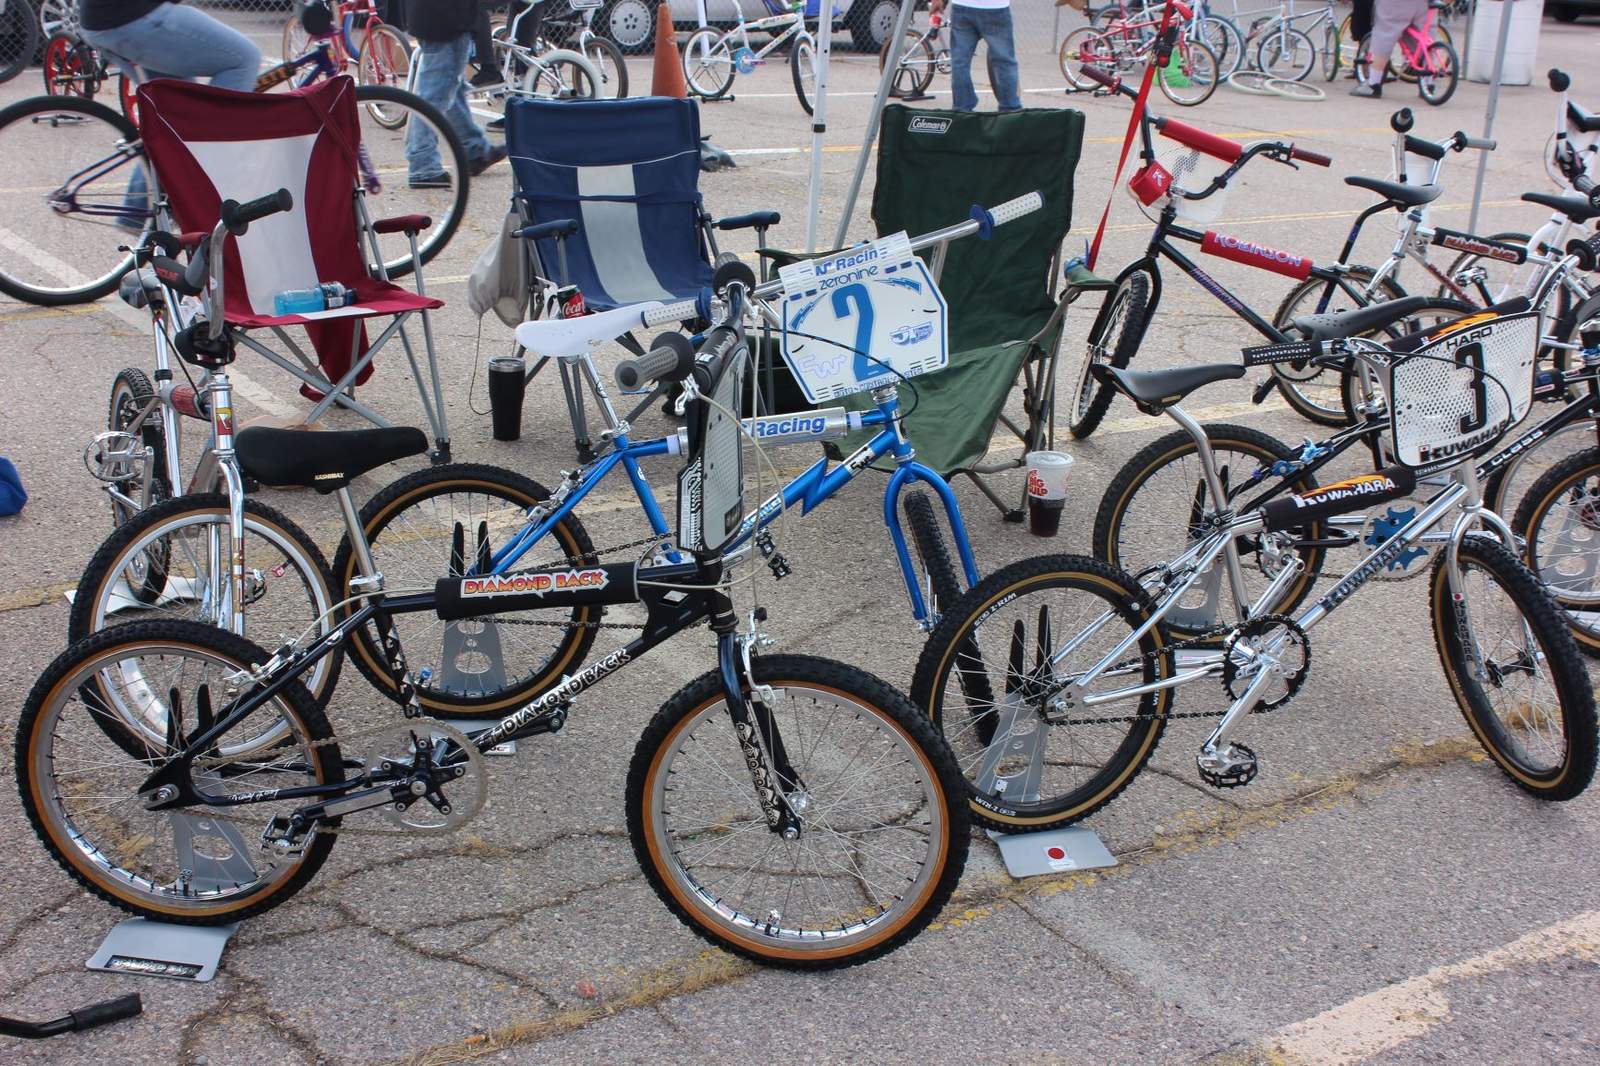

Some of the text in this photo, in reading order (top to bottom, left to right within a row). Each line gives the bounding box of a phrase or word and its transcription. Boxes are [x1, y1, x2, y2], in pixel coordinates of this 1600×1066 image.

[836, 249, 878, 270] Racin
[819, 265, 878, 290] zeronine
[831, 283, 891, 382] 2
[1446, 326, 1493, 350] HARO
[1454, 342, 1488, 435] 3
[755, 417, 826, 437] Racing
[1291, 477, 1396, 508] KUWAHARA
[464, 570, 604, 595] DIAMOND BACK
